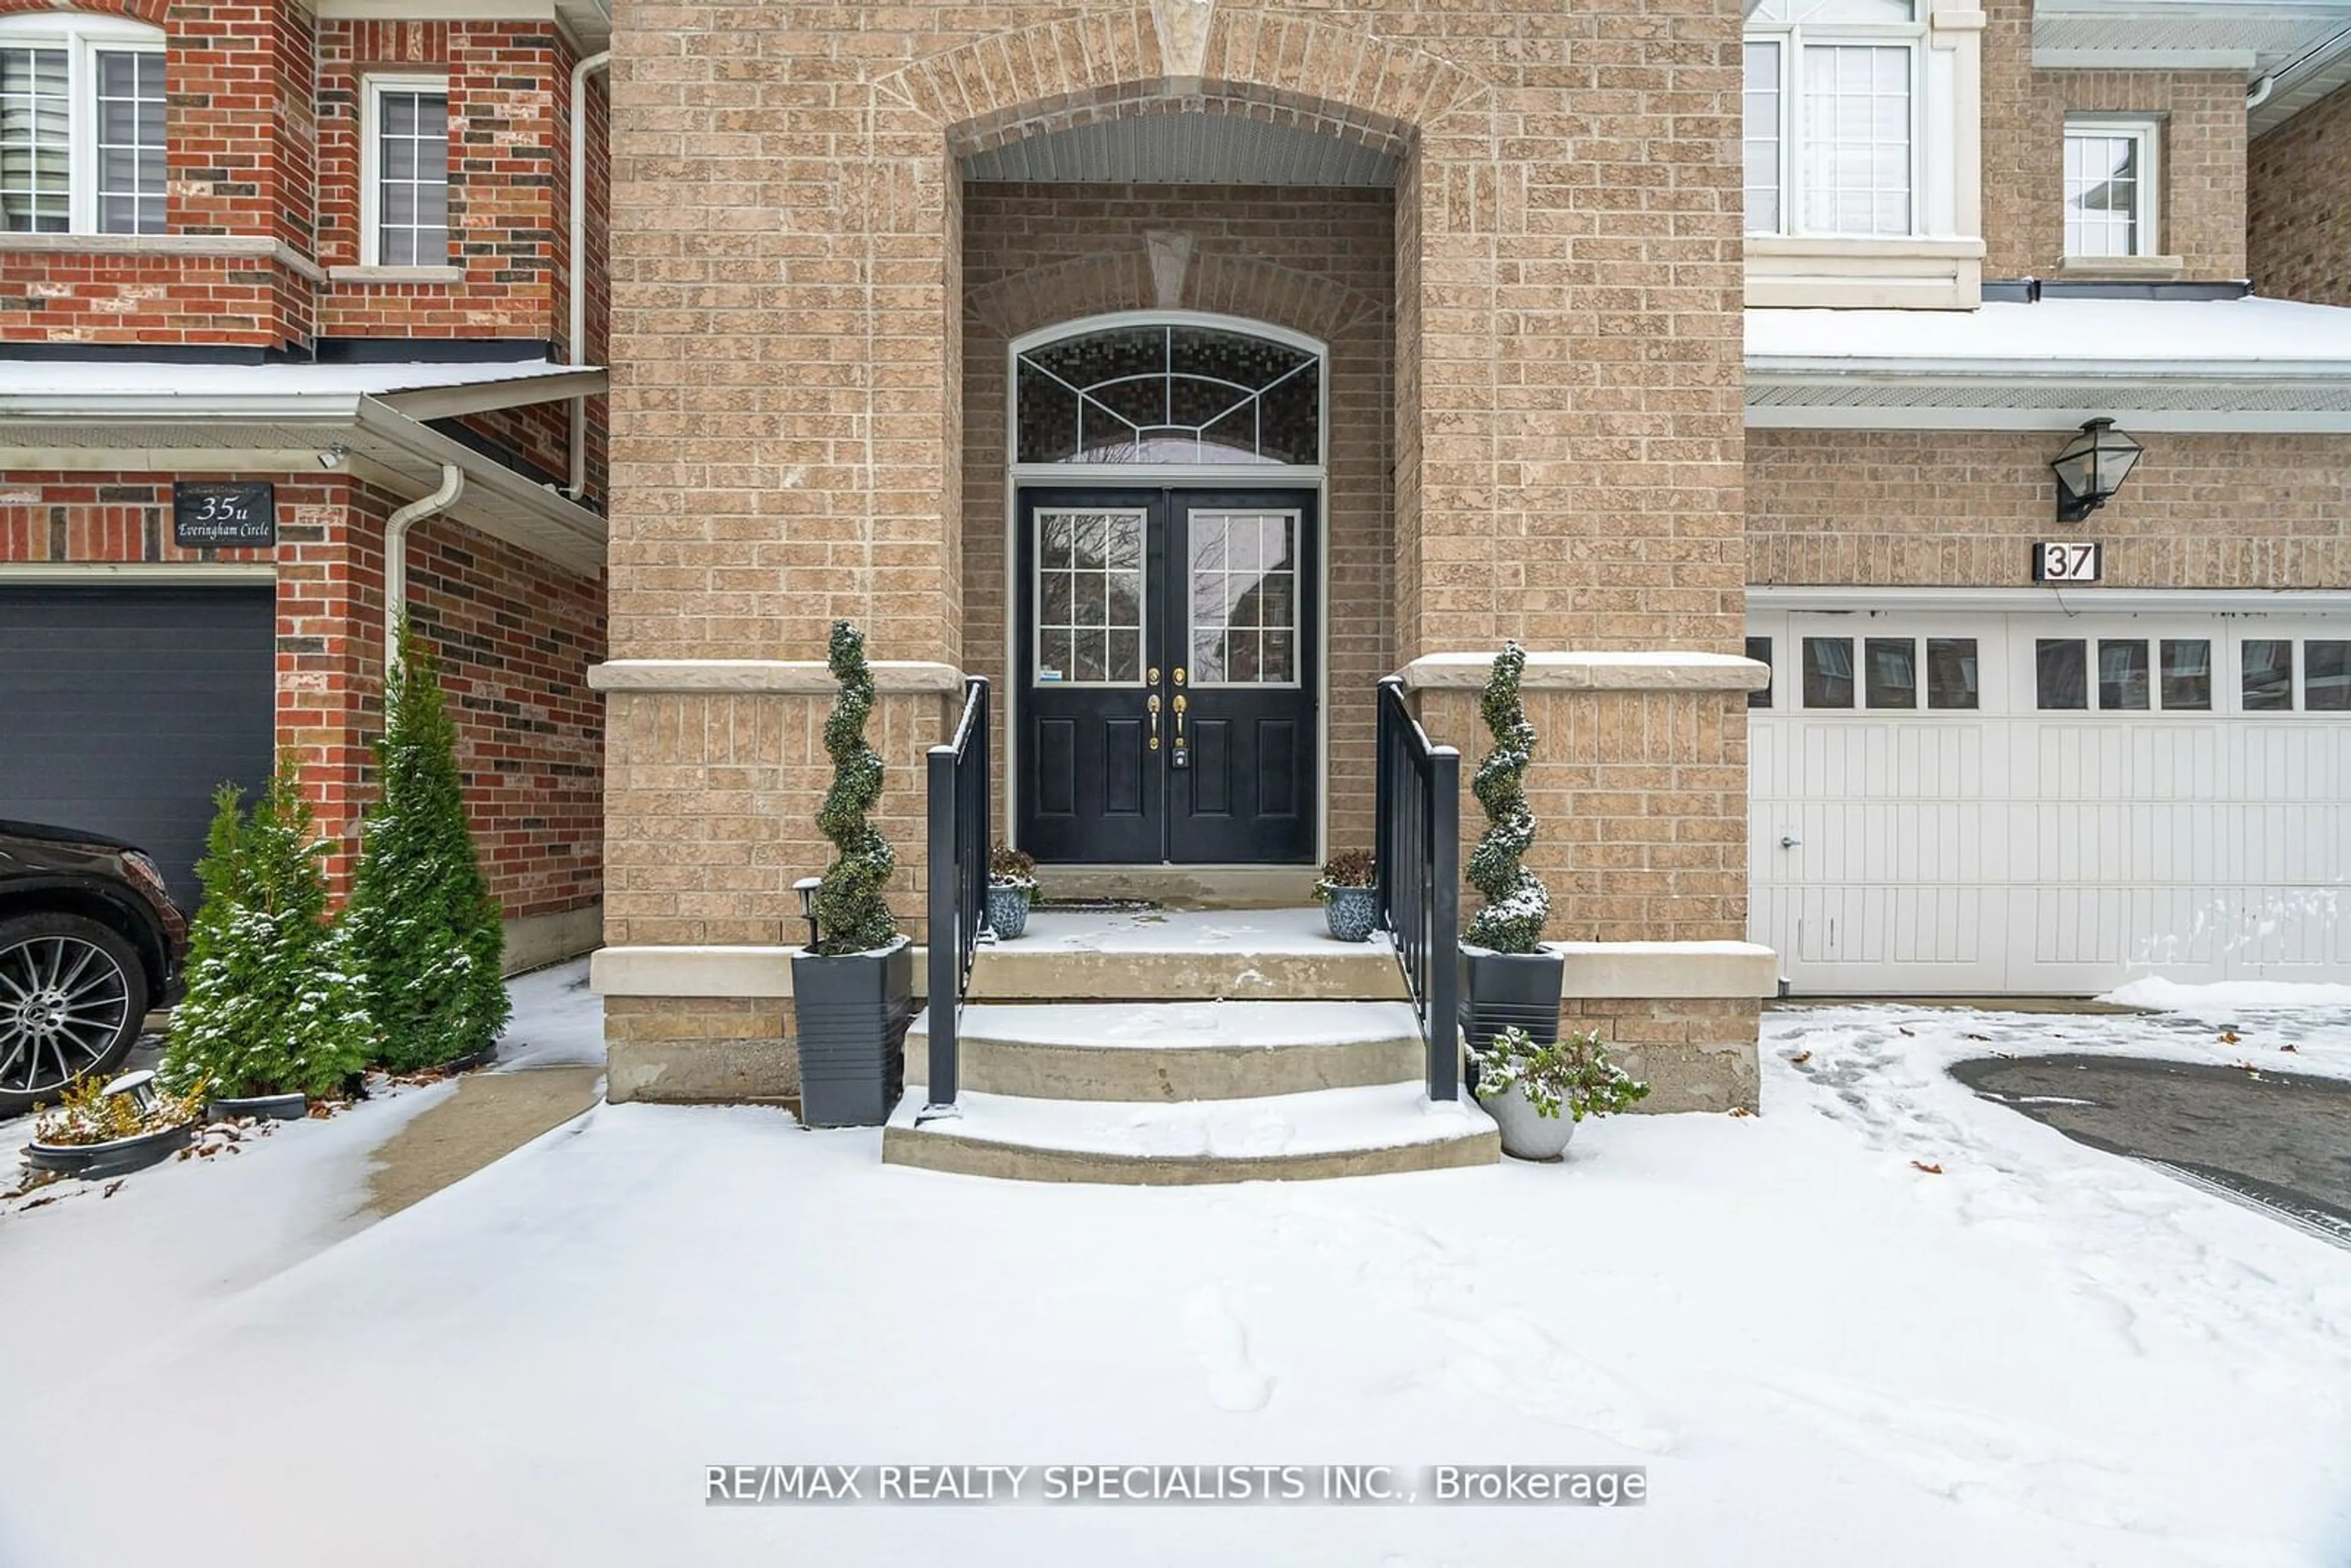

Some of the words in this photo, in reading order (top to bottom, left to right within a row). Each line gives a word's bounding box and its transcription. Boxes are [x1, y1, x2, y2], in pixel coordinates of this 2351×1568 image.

[178, 522, 238, 540] Everingham
[241, 521, 269, 537] Circle
[2047, 546, 2092, 577] 37
